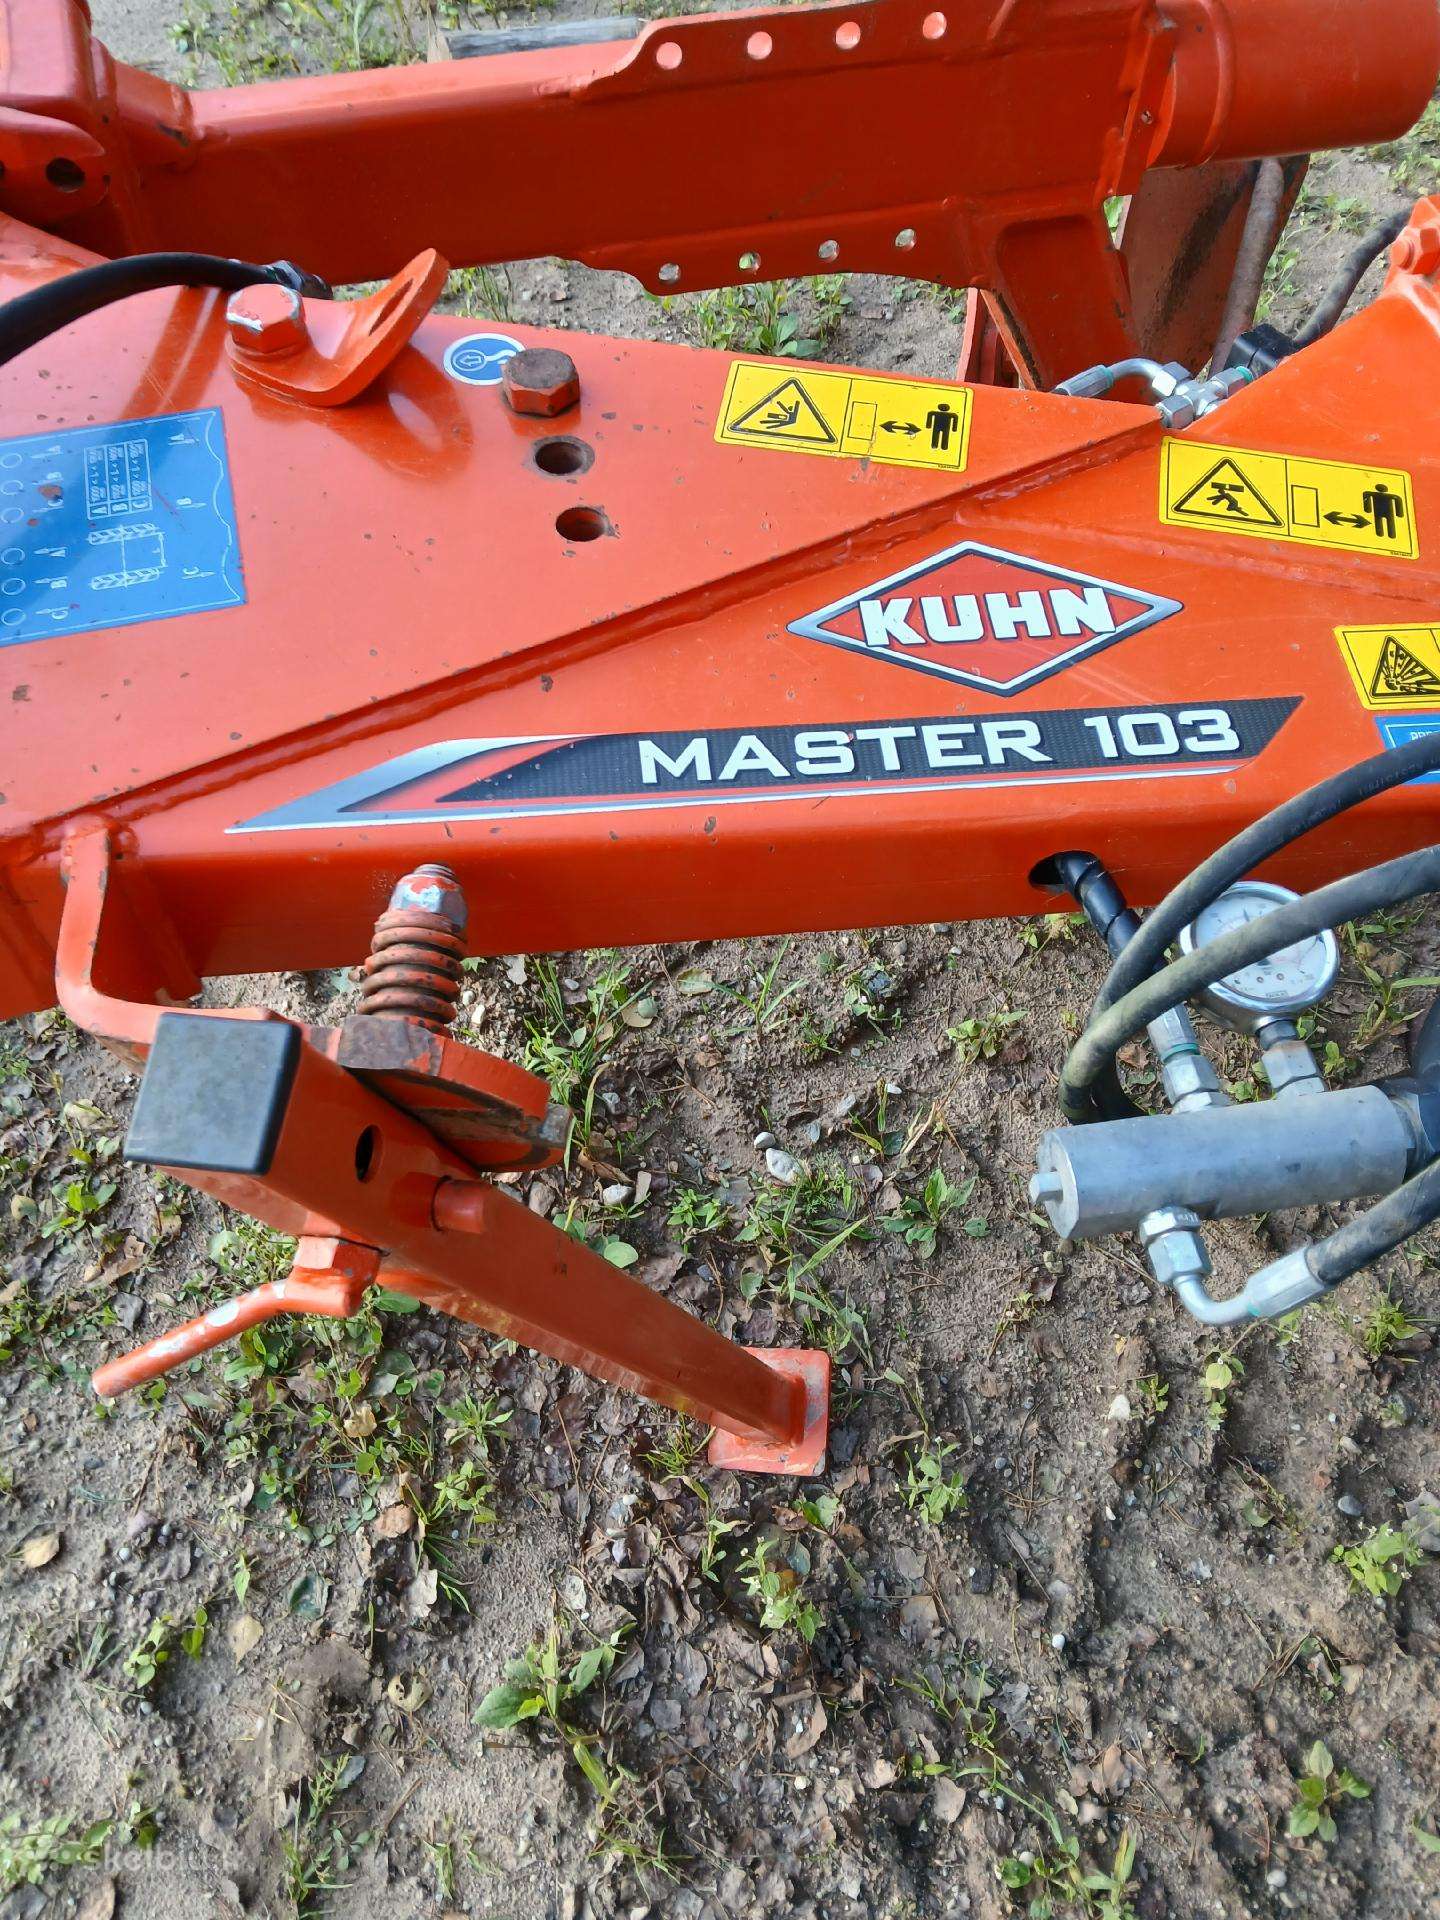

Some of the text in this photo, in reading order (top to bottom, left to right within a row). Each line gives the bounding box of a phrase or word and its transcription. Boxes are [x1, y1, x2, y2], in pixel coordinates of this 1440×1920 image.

[858, 586, 1117, 648] KUHN
[637, 708, 1241, 785] MASTER 103
